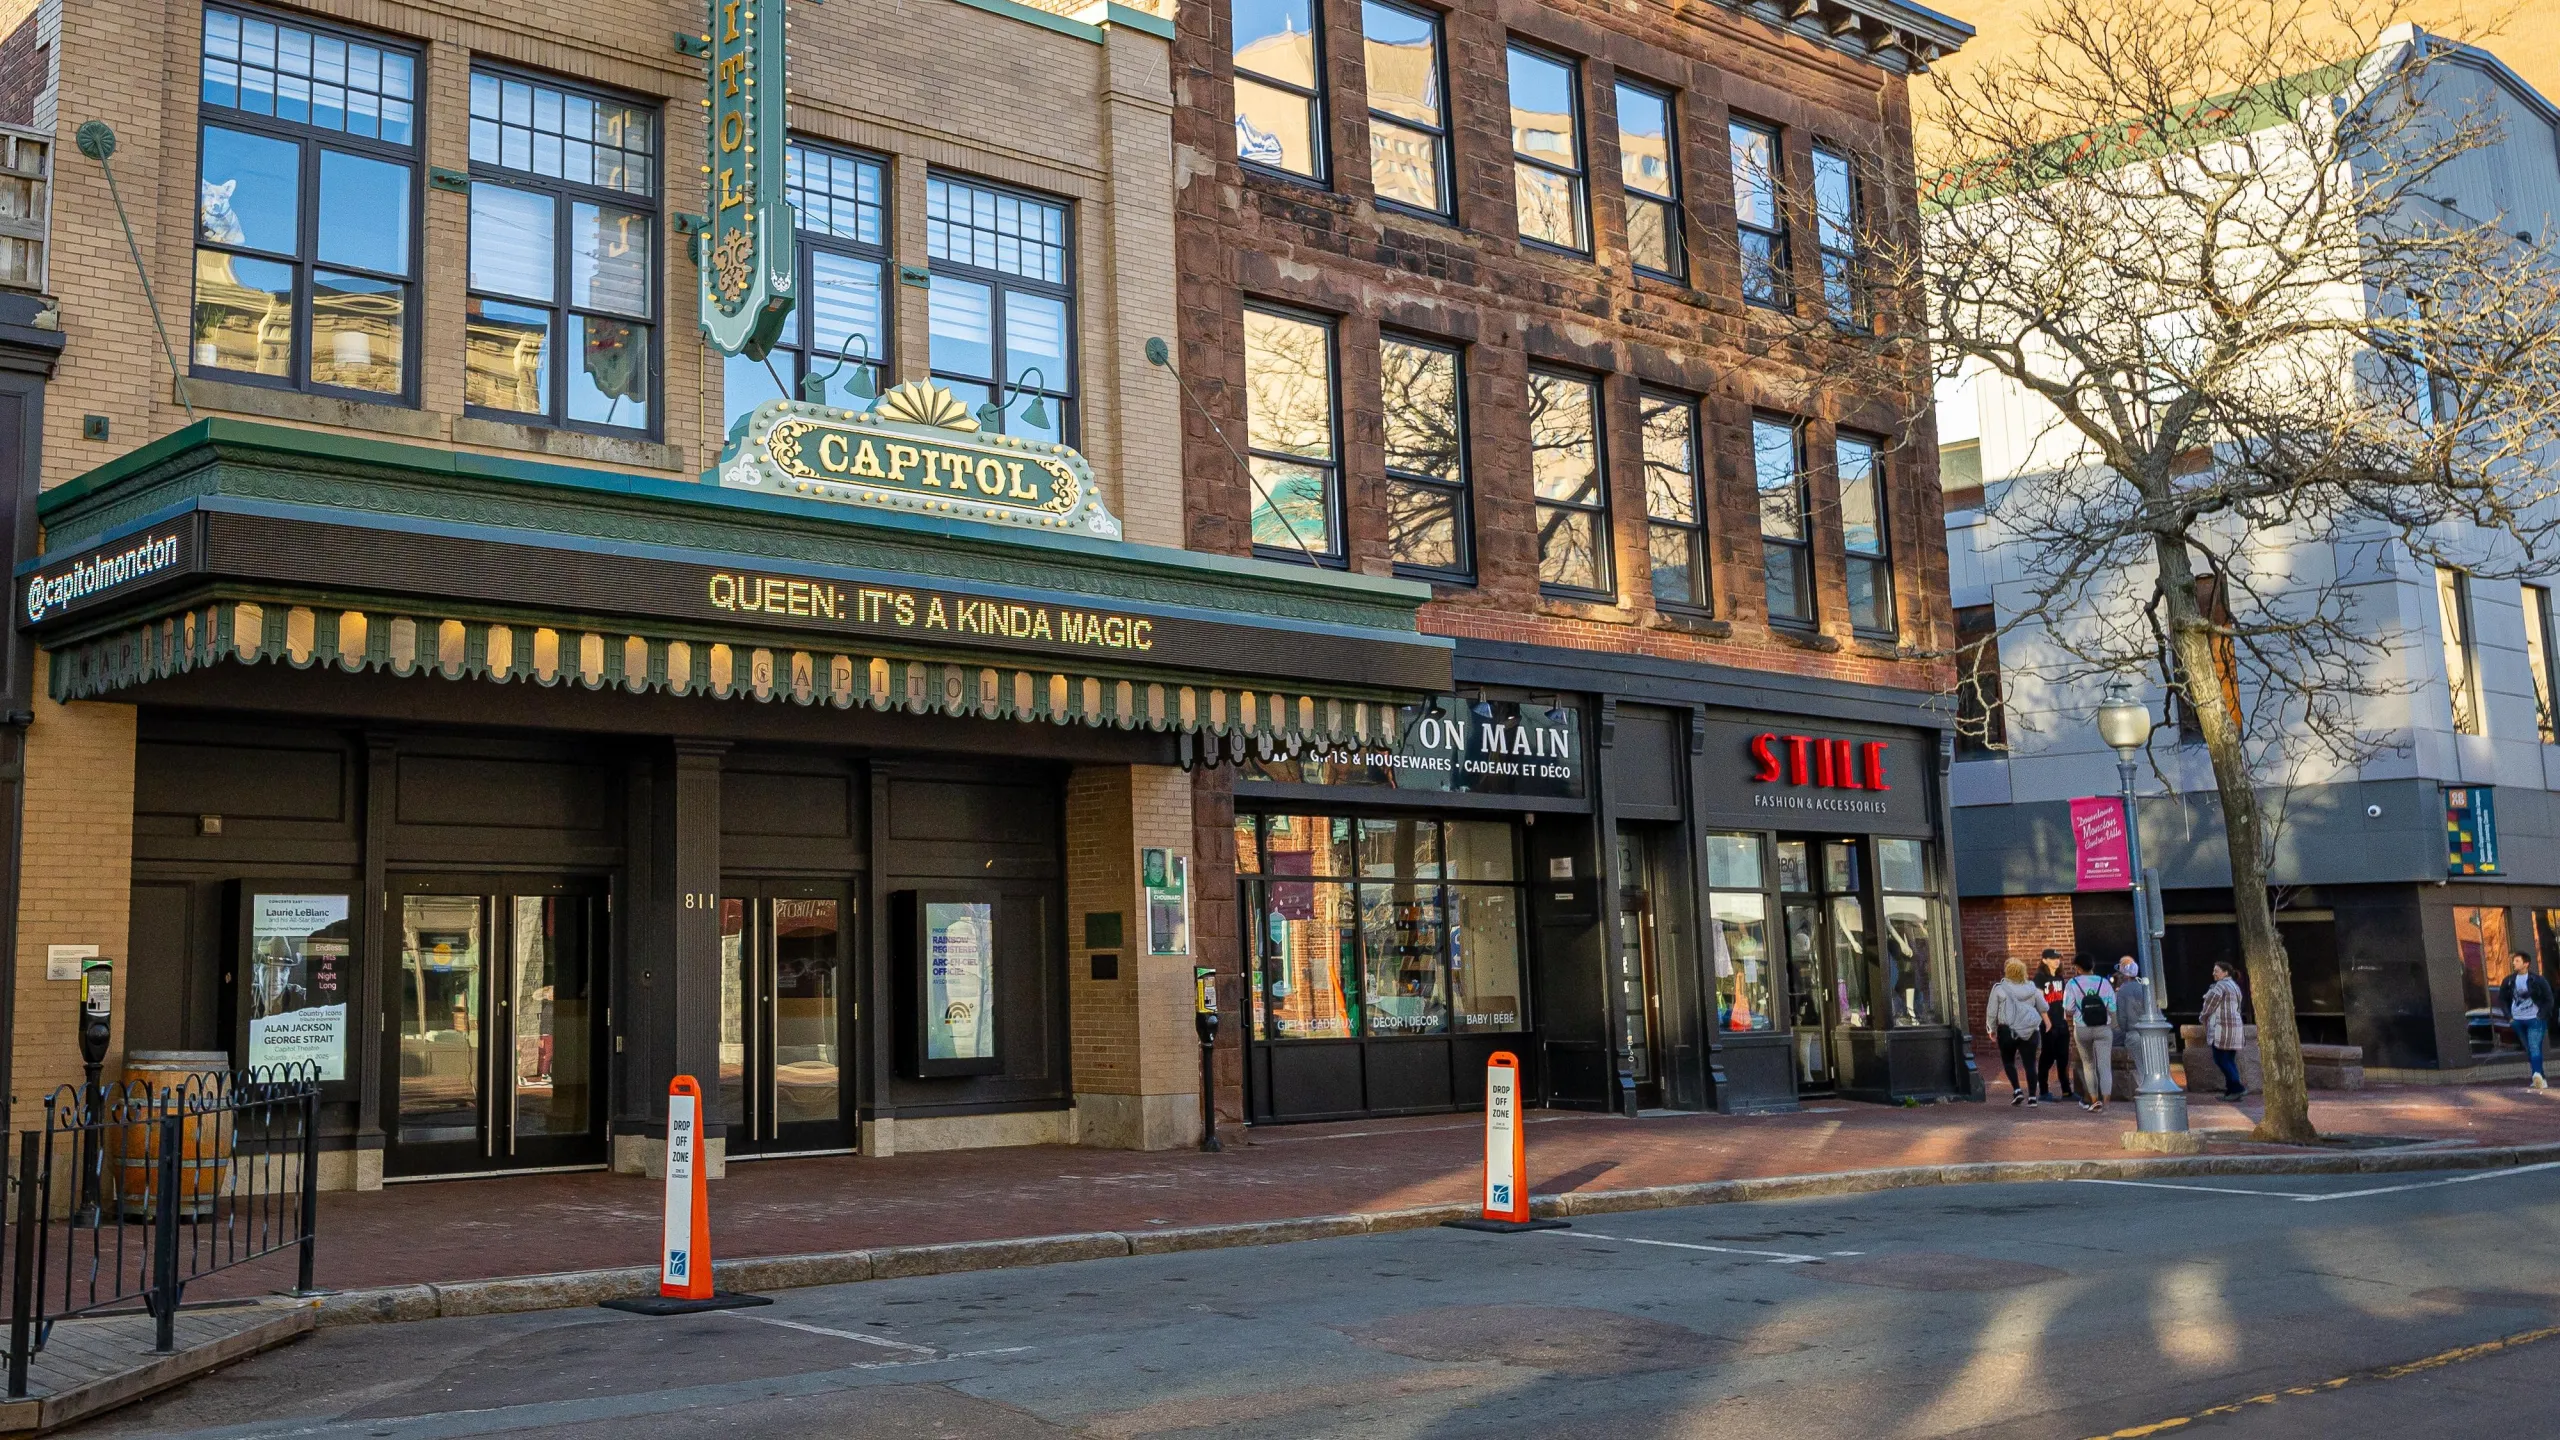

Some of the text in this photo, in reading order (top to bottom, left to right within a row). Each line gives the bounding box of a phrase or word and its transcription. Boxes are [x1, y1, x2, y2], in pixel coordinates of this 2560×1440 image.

[818, 433, 1038, 501] CAPITOL
[28, 535, 177, 621] @capitolmoncton
[709, 574, 1153, 651] QUEEN: IT'S A KINDA MAGIC
[754, 662, 995, 702] CAPITOL
[1419, 718, 1569, 759] ON MAIN
[1352, 753, 1361, 765] &
[1366, 752, 1452, 771] HOUSEWARES
[1464, 759, 1519, 776] CADEAUX
[1523, 764, 1536, 777] ET
[1540, 761, 1571, 779] DÉCO
[1752, 732, 1892, 791] STILE
[1755, 794, 1886, 814] FASHION & ACCESSORIES
[2077, 806, 2114, 827] Downtown
[2083, 818, 2116, 839] Moncton
[2085, 827, 2121, 850] Centre-Ville
[685, 893, 714, 909] 811
[266, 908, 329, 917] Laurie LeBlanc
[933, 936, 968, 944] RAINBOW
[933, 958, 978, 966] ARC-EN-CIEL
[317, 972, 337, 981] Night
[319, 982, 337, 991] Long
[1277, 1017, 1354, 1030] GIFTS CADEAUX
[1373, 1016, 1403, 1028] DECOR
[1466, 1011, 1514, 1025] BABY BÉBÉ
[264, 1023, 333, 1033] ALAN JACKSON
[264, 1035, 334, 1045] GEORGE STRAIT
[1493, 1086, 1510, 1094] DROP
[1495, 1097, 1507, 1106] OFF
[1493, 1109, 1509, 1118] ZONE
[673, 1120, 691, 1131] DROP
[675, 1136, 687, 1147] OFF
[672, 1152, 689, 1163] ZONE
